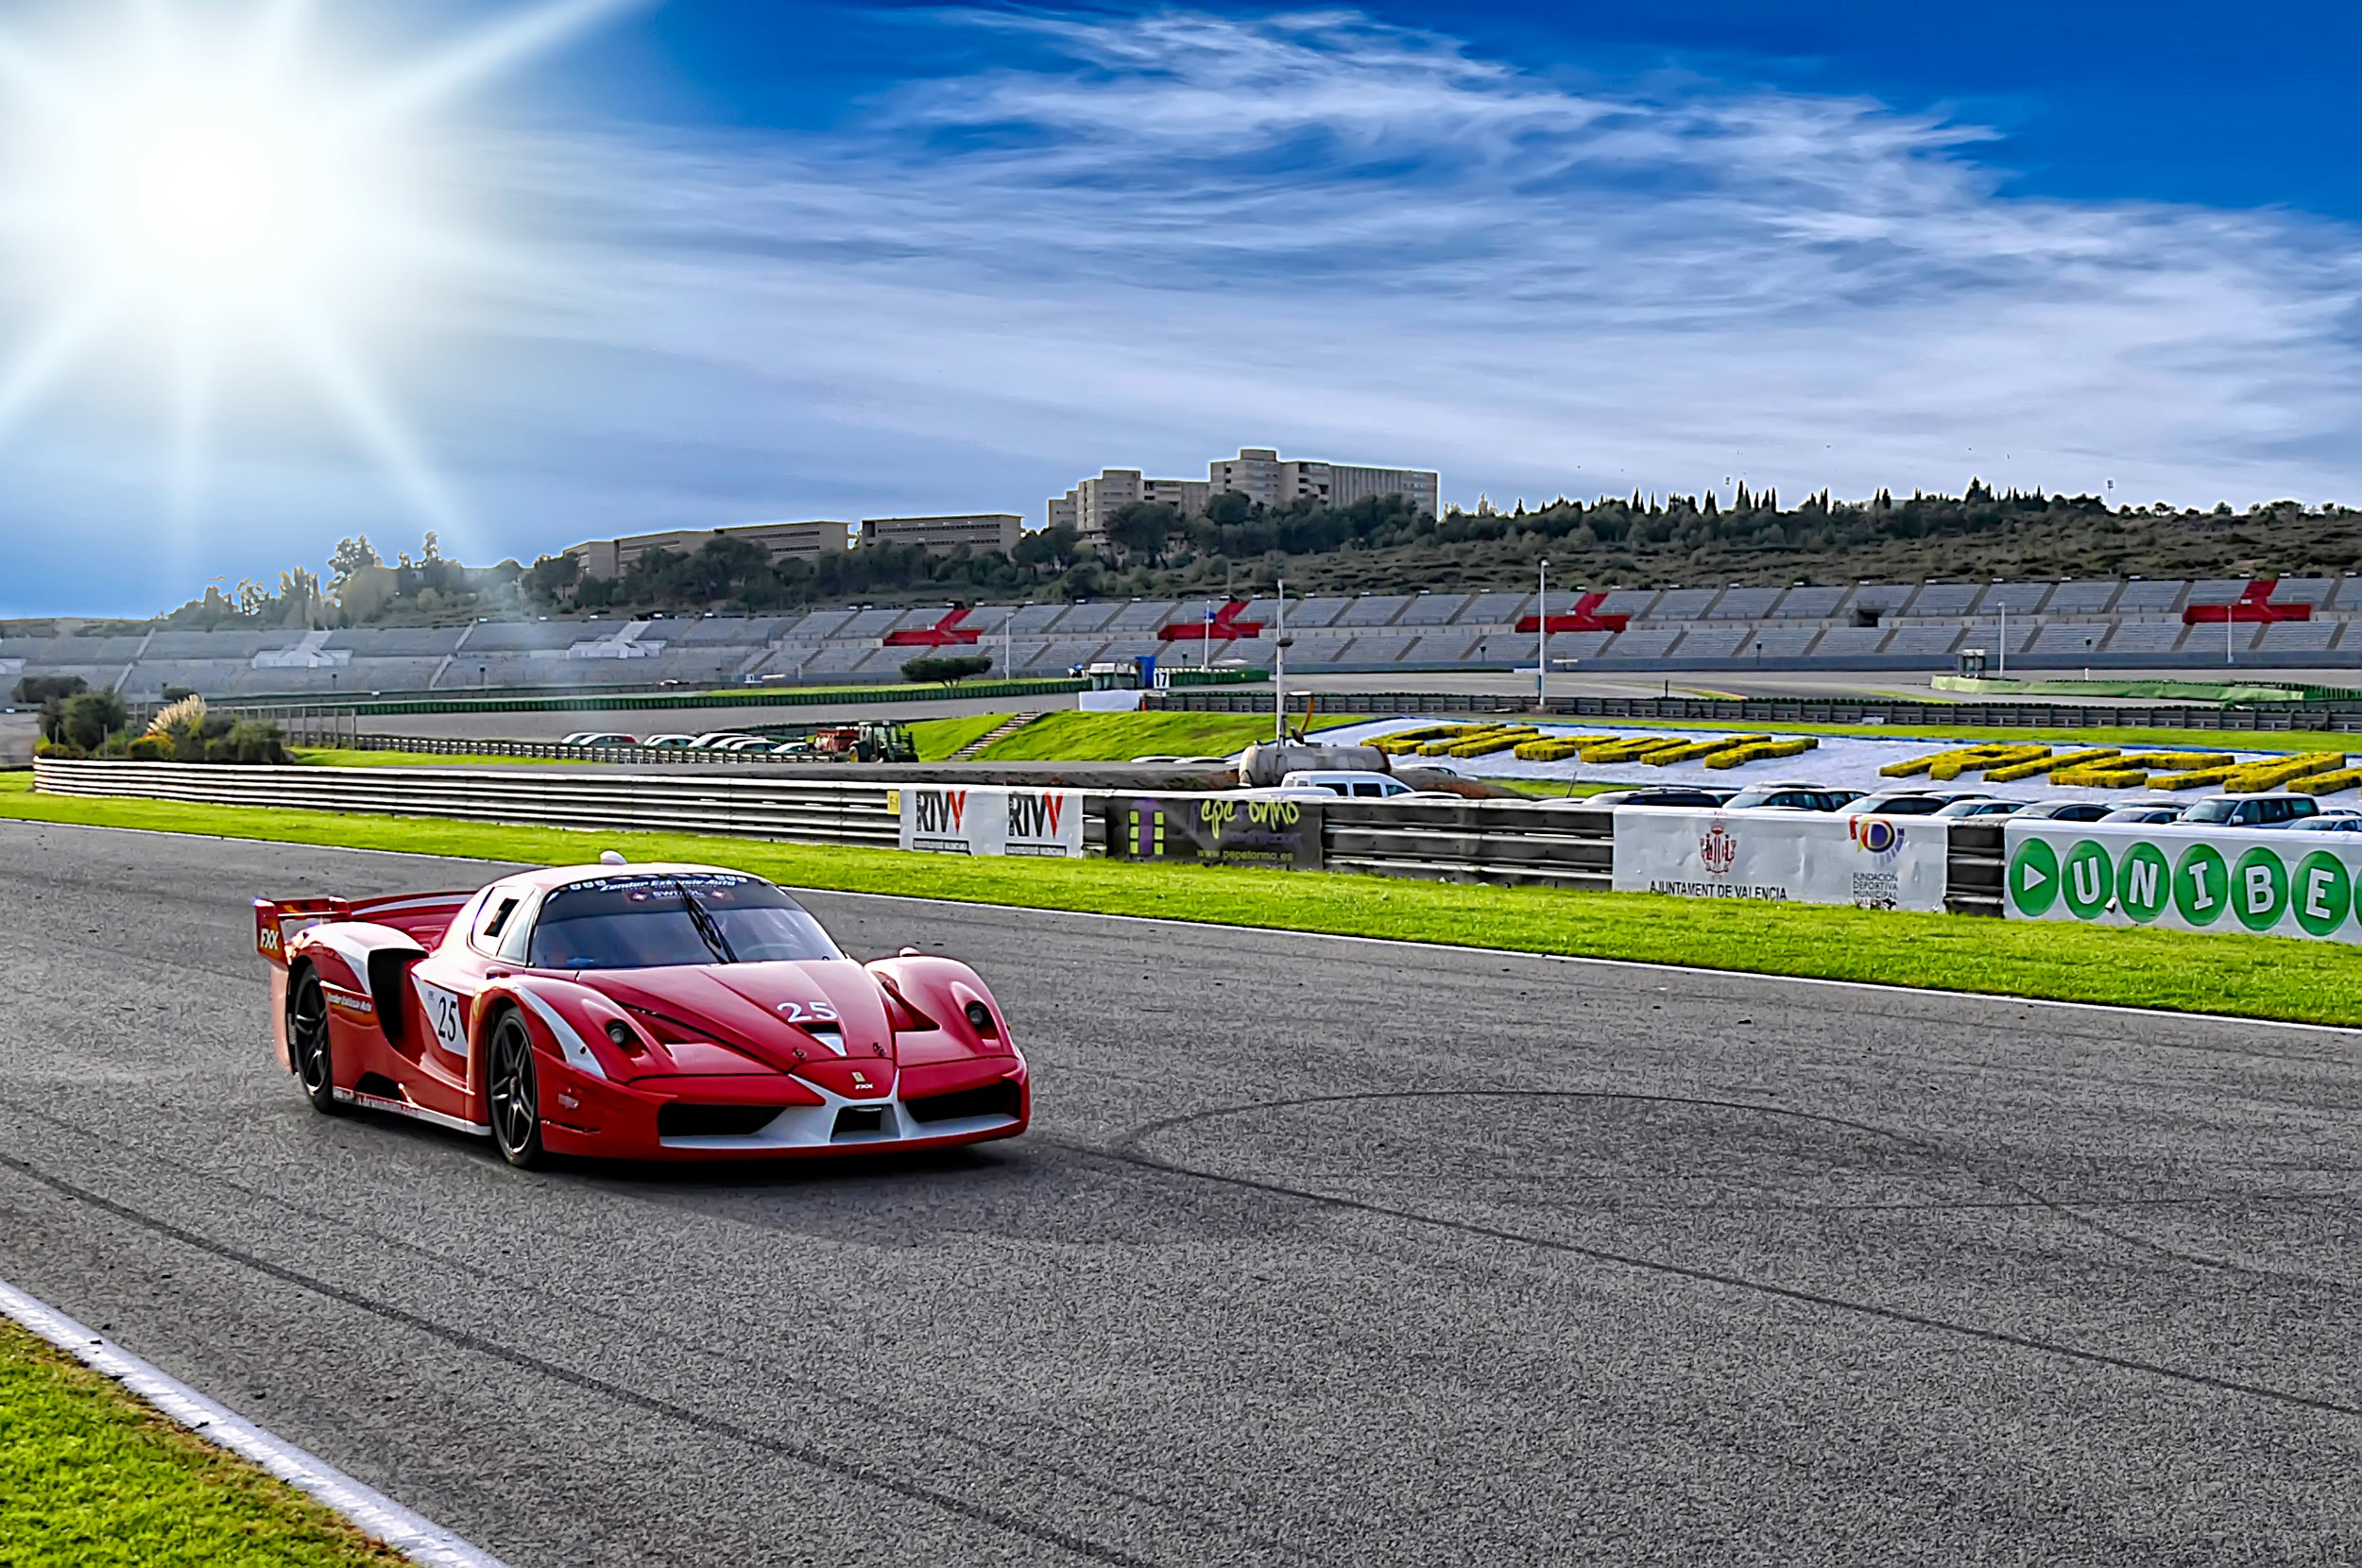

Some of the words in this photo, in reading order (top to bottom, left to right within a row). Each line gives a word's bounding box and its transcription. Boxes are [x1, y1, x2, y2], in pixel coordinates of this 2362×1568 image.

[1155, 673, 1167, 687] 17
[1649, 880, 1715, 896] AJUNTAMENT
[1717, 884, 1732, 897] DE
[1734, 885, 1788, 900] VALENCIA
[1853, 880, 1898, 891] DEPORTIVA
[1853, 890, 1897, 899] MUNICIPAL
[260, 928, 279, 951] FXX
[437, 997, 457, 1042] 25
[777, 1001, 838, 1023] 25
